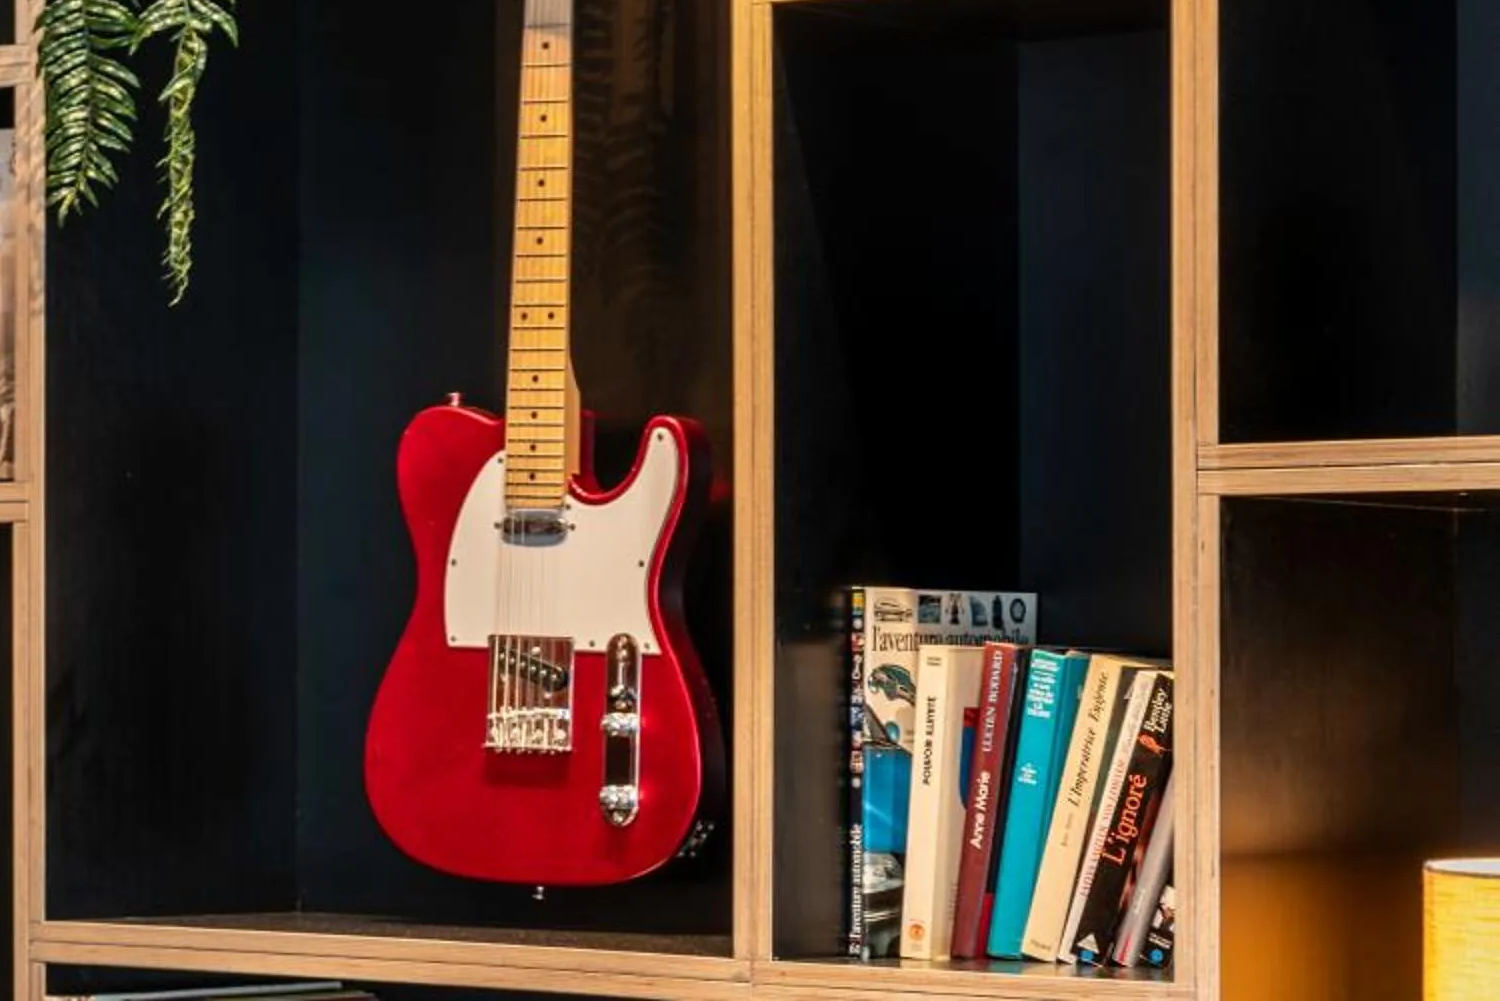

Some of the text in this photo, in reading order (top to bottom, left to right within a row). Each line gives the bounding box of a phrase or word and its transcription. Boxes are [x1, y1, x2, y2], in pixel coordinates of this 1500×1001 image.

[982, 707, 996, 752] LUCIEN
[1142, 687, 1167, 733] Bentley
[968, 770, 992, 851] Anne Marie
[1103, 773, 1149, 867] L'ignoré
